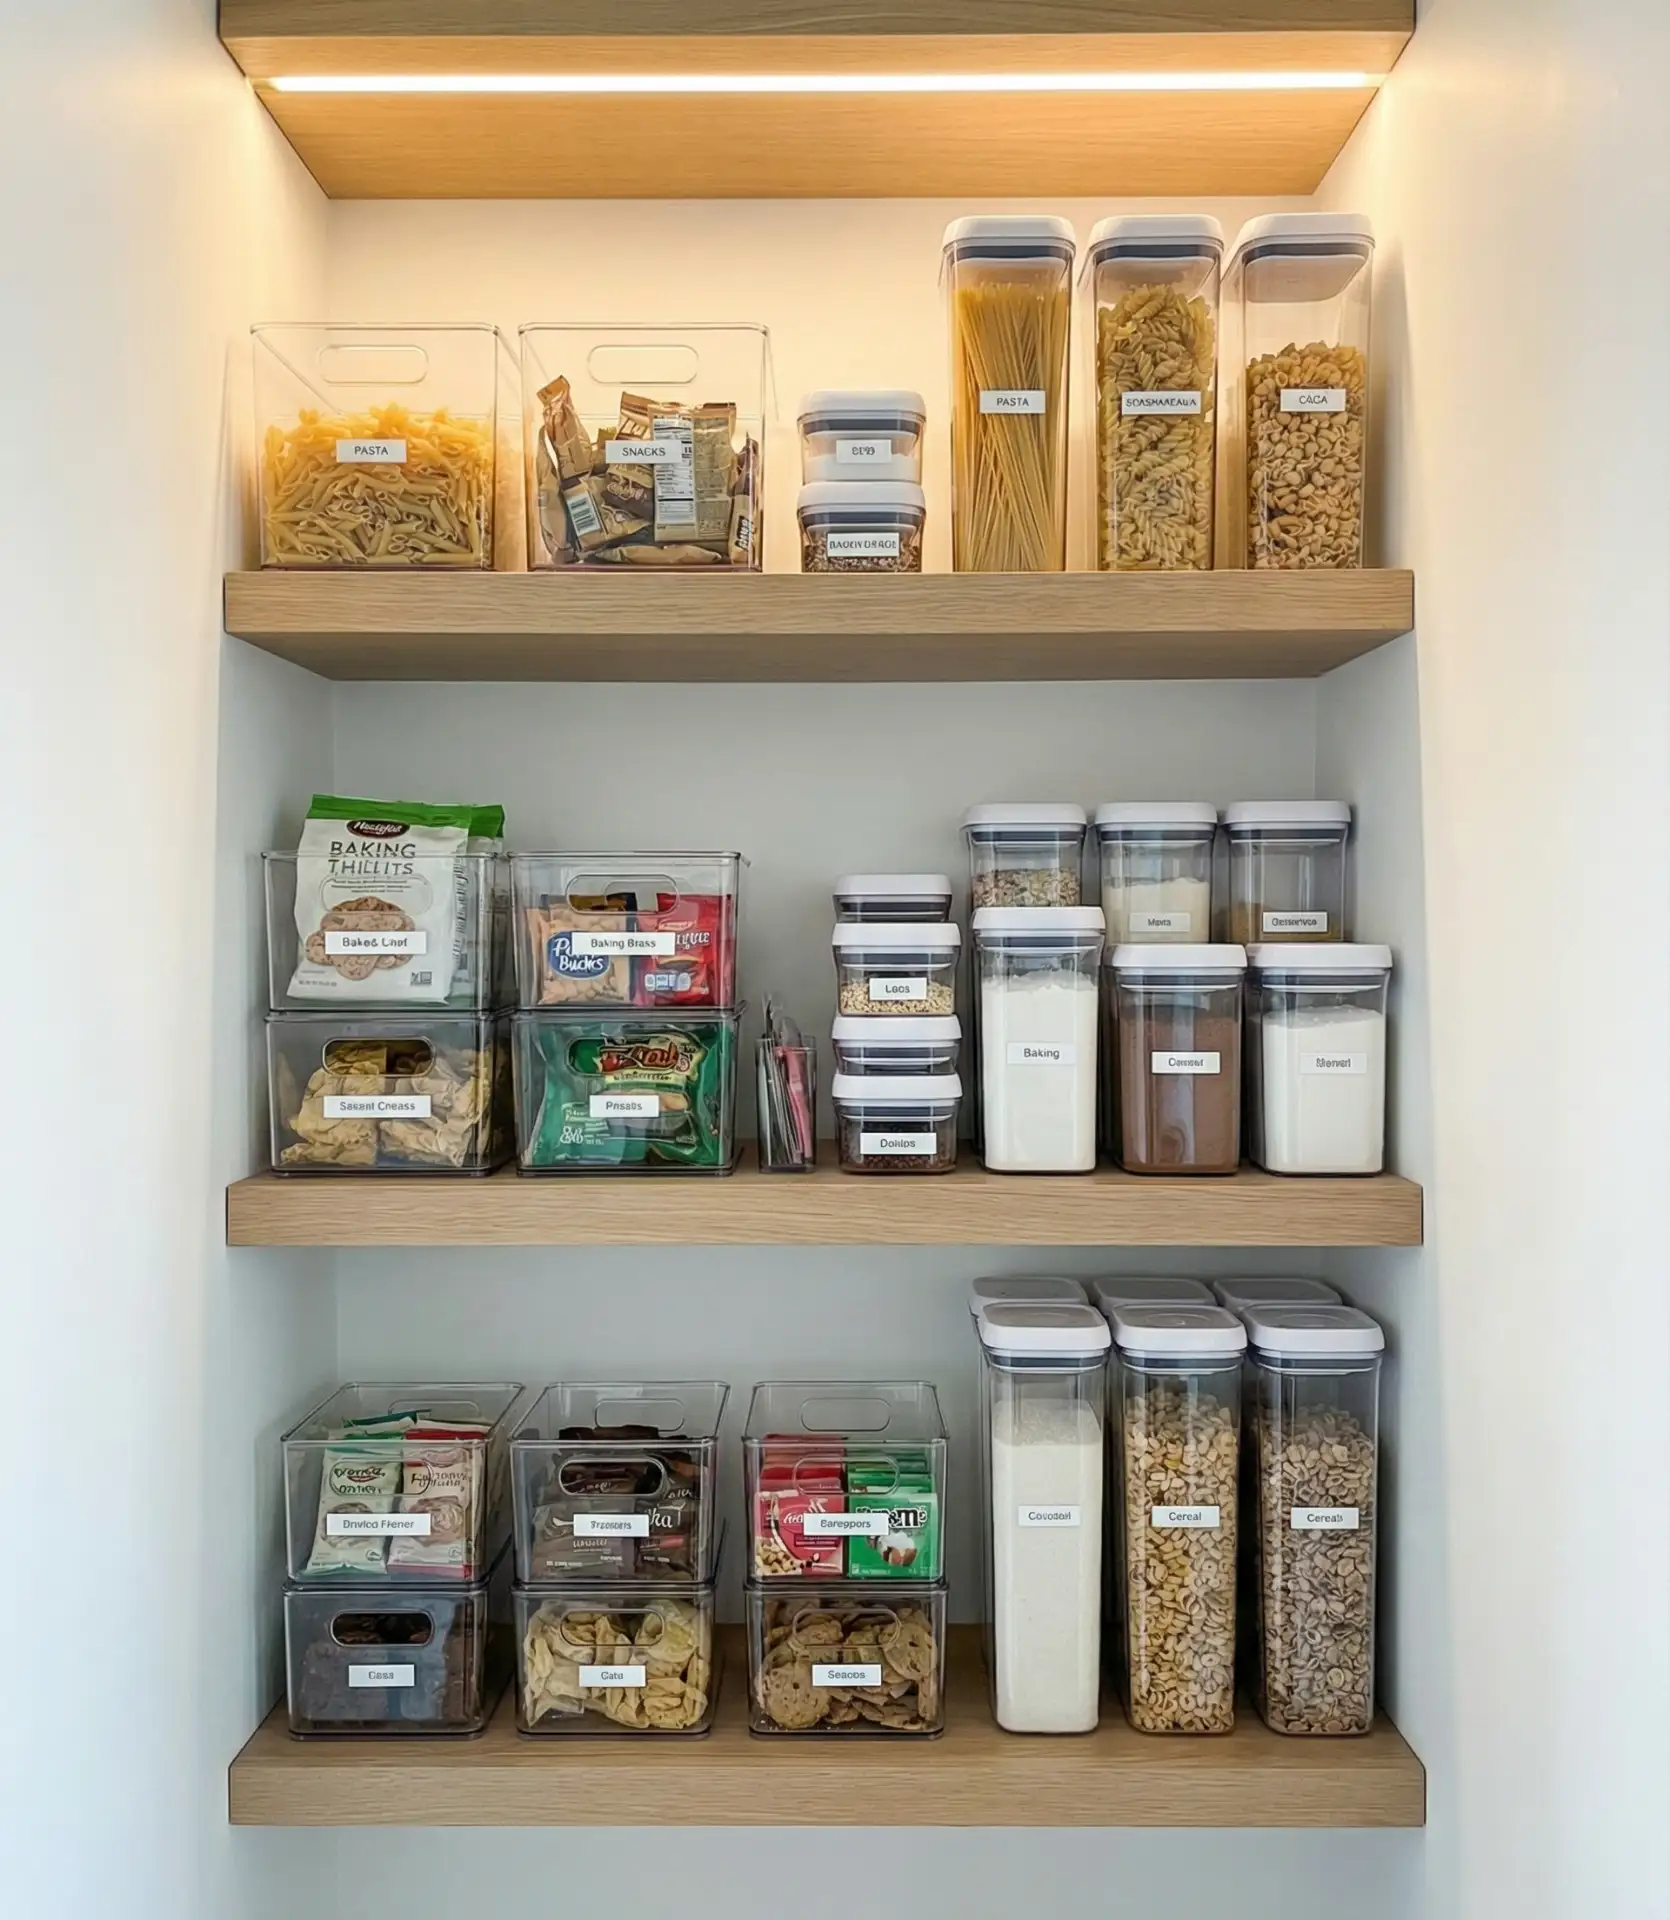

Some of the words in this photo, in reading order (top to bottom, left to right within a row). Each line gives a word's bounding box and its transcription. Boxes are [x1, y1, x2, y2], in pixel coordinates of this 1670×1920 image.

[997, 397, 1030, 407] PASTA
[355, 446, 389, 456] PASTA
[622, 447, 666, 457] SNACKS
[329, 841, 416, 858] BAKING
[1023, 1047, 1060, 1061] Baking
[1168, 1511, 1202, 1521] Cereal
